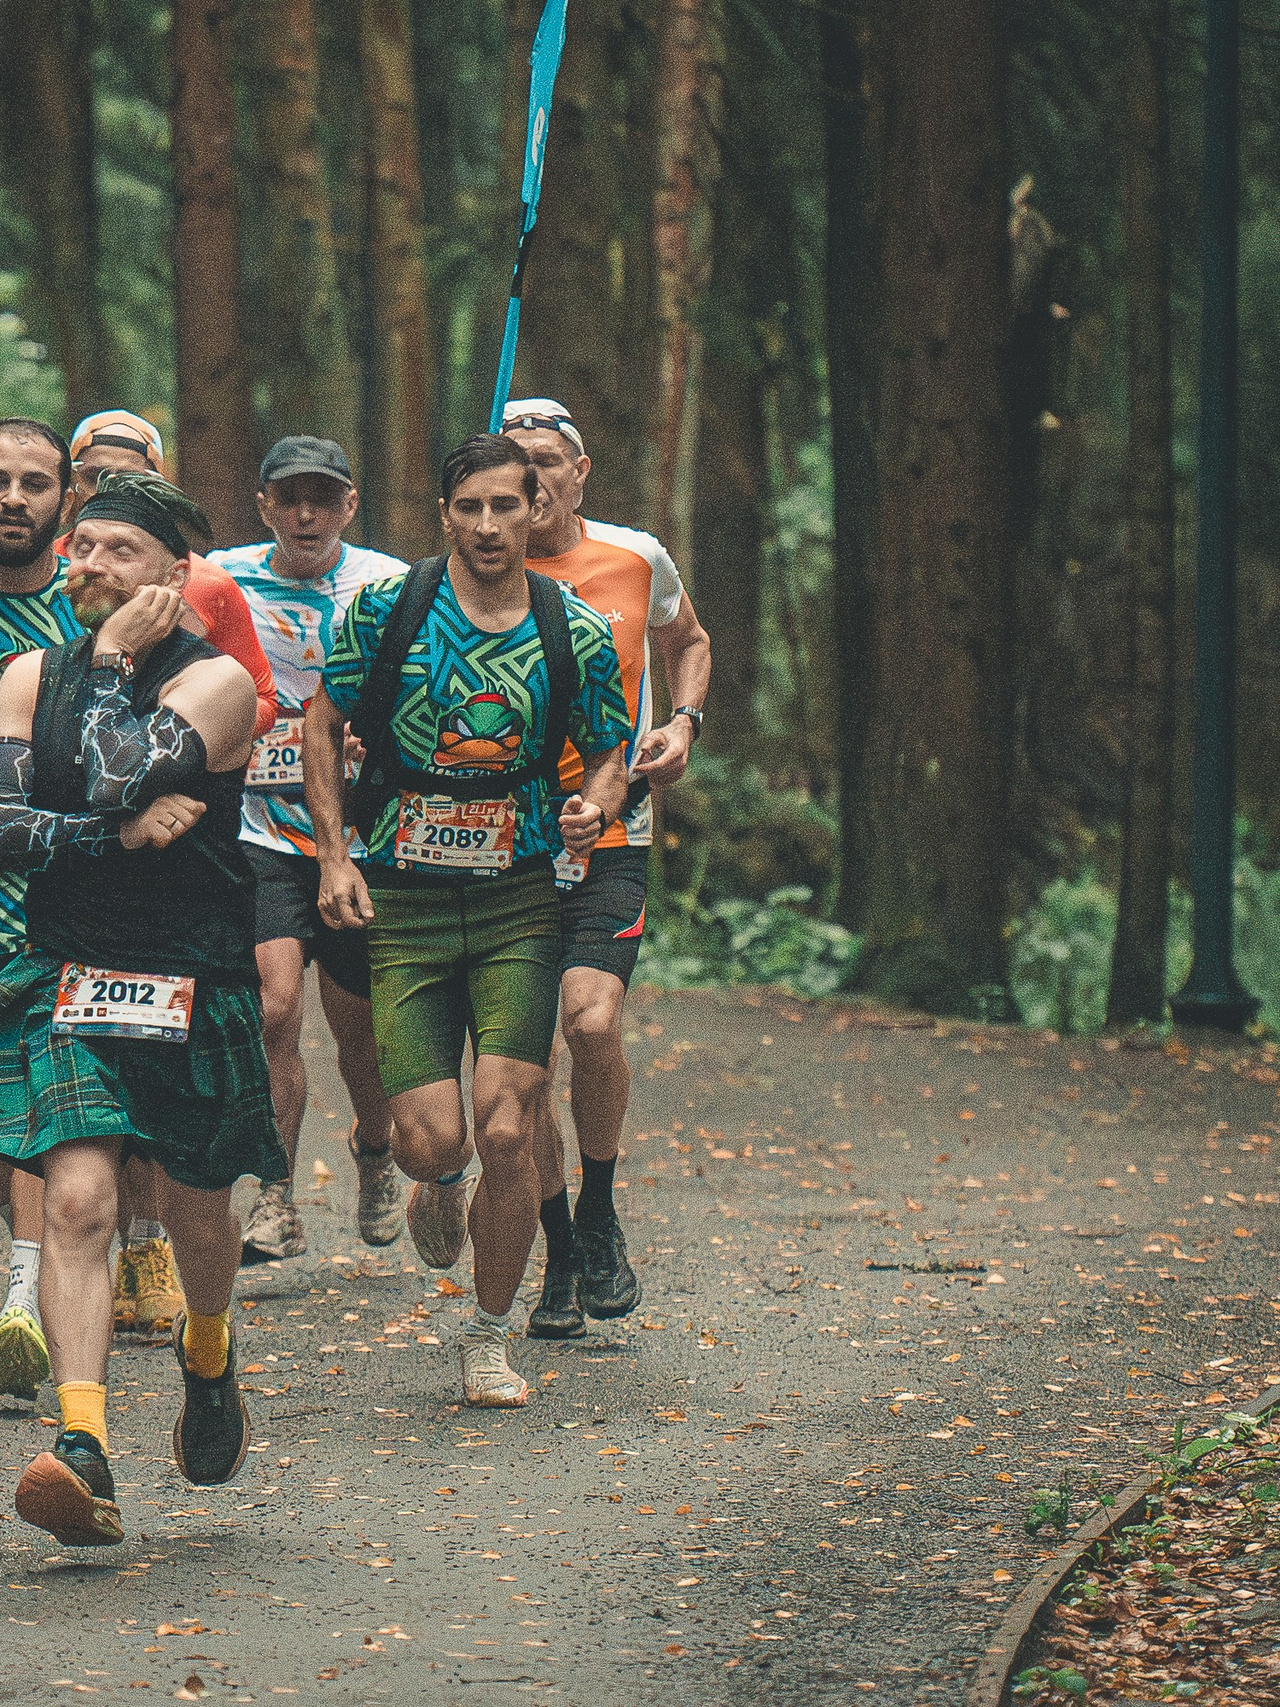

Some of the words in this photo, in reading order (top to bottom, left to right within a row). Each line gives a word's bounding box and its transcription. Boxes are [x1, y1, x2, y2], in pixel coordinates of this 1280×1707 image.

[268, 747, 302, 767] 20
[422, 825, 488, 848] 2089
[90, 980, 156, 1005] 2012
